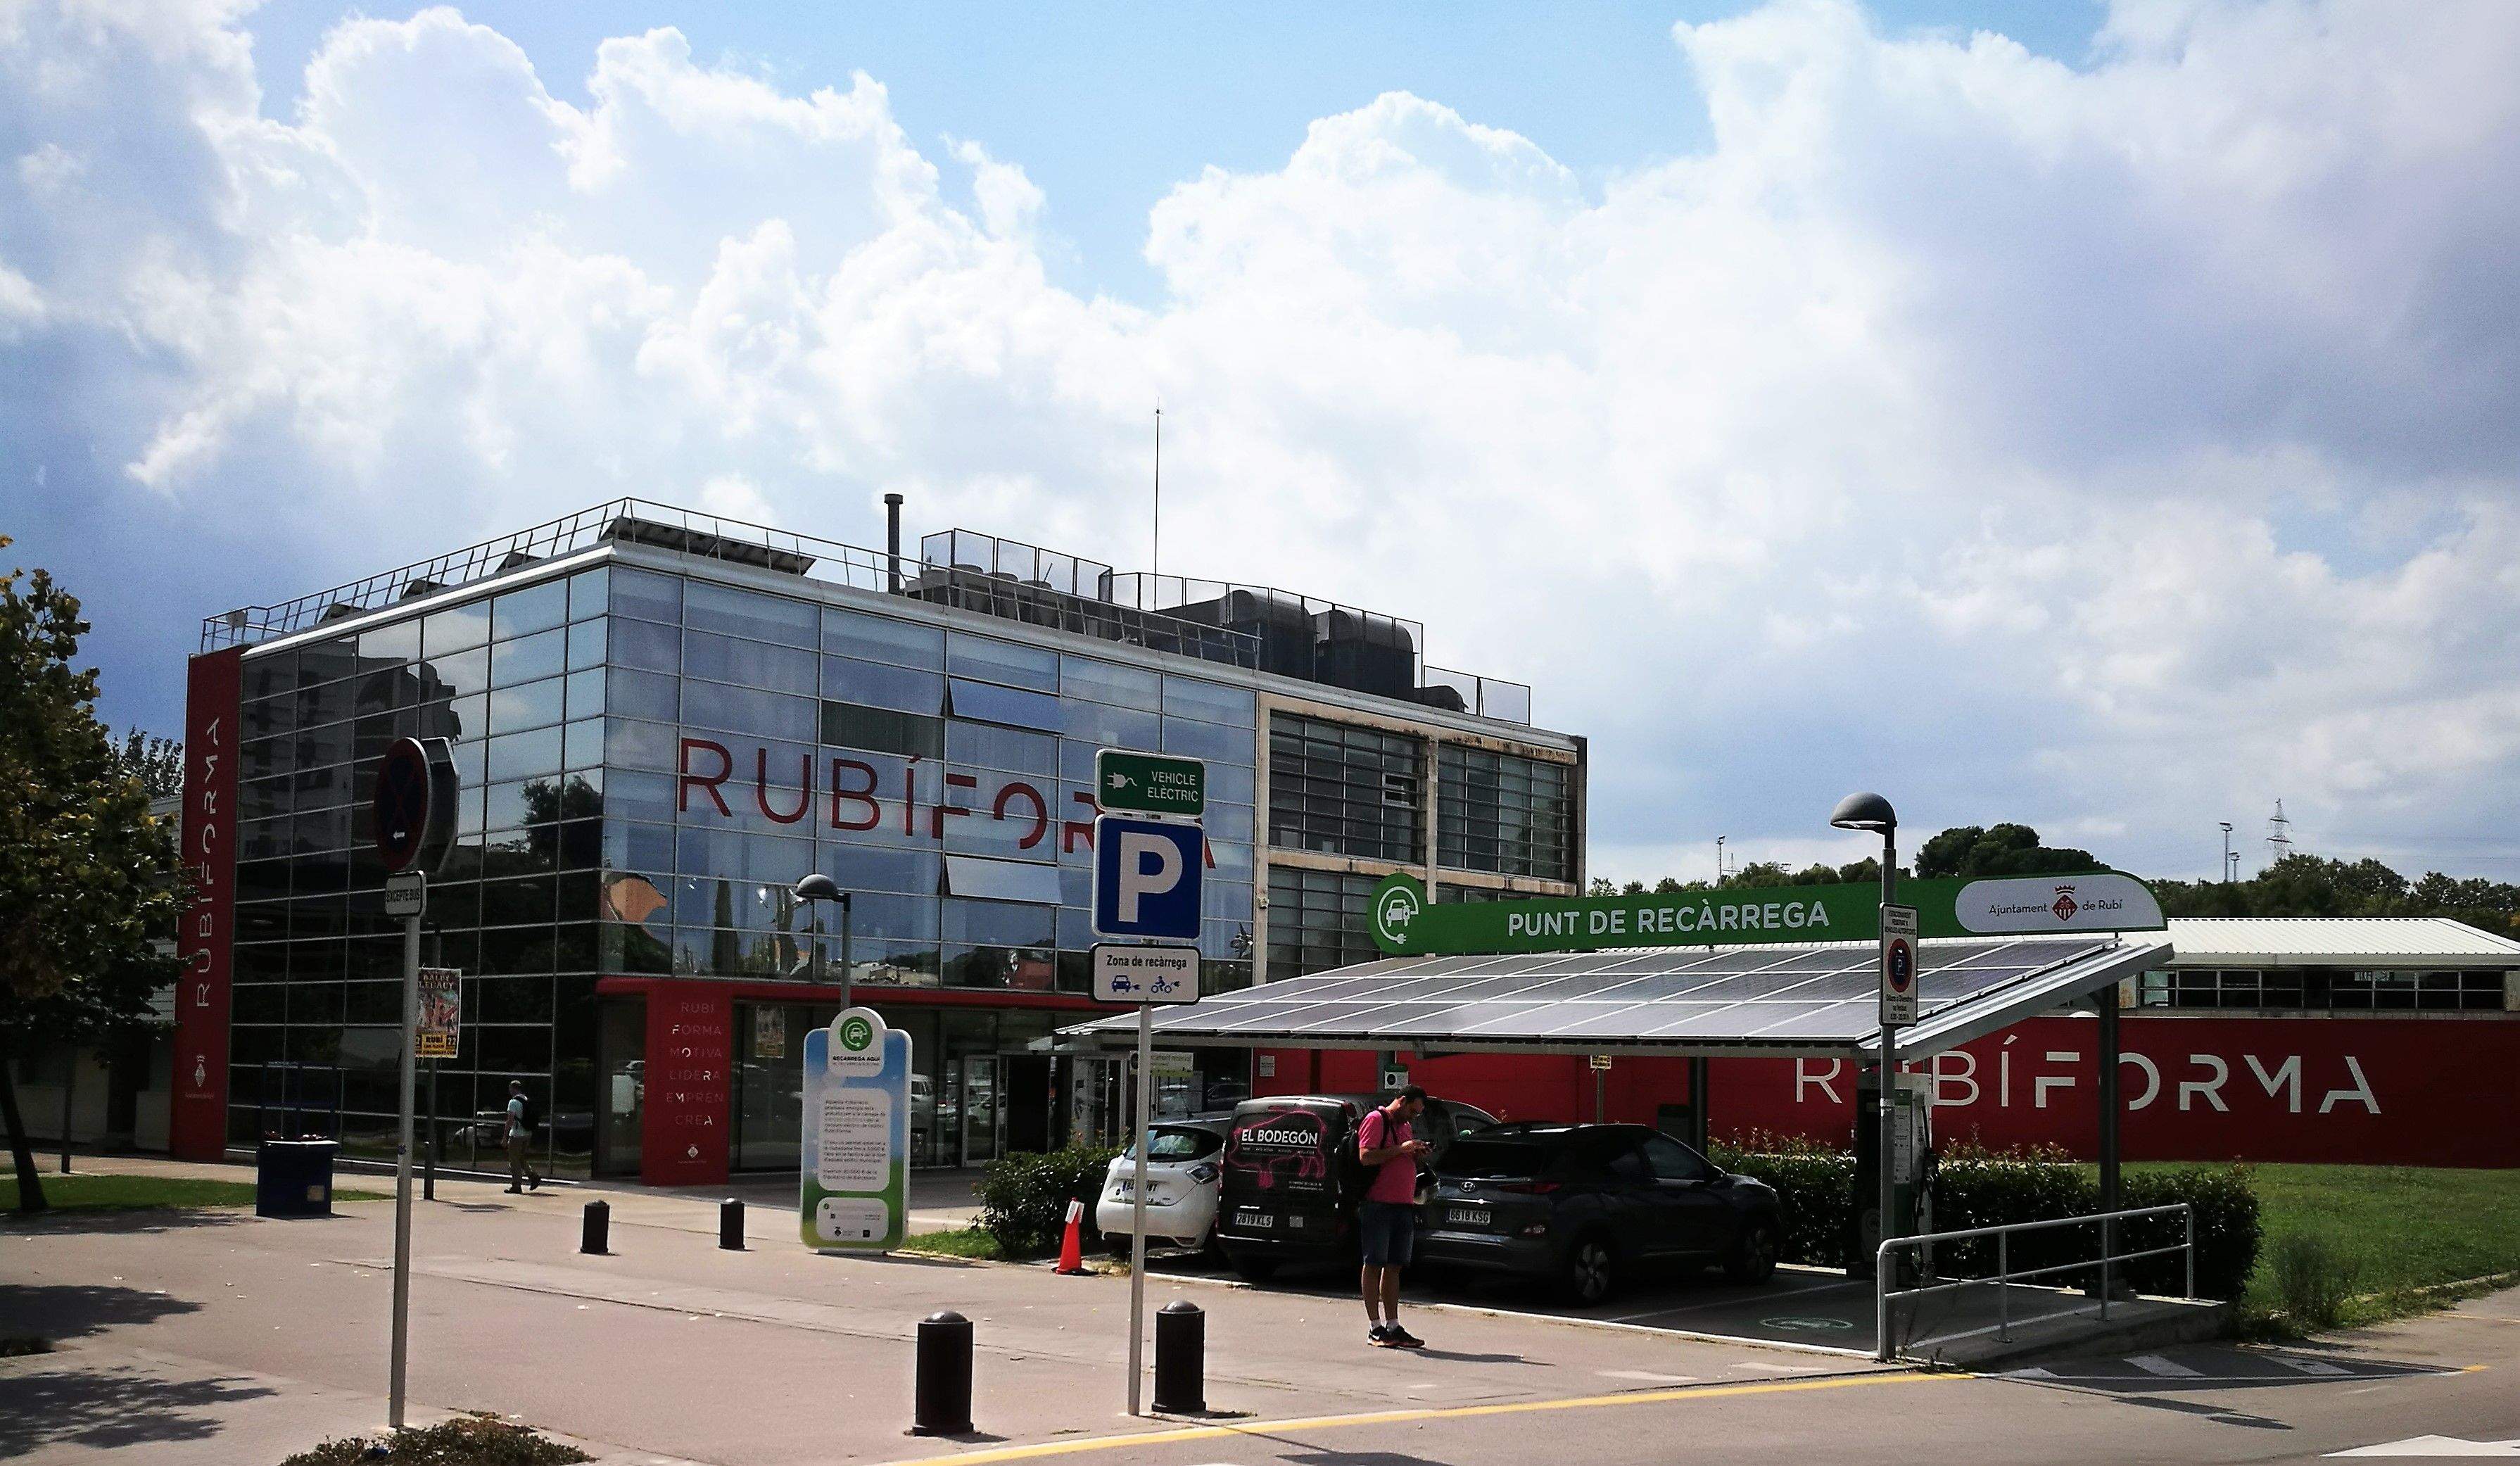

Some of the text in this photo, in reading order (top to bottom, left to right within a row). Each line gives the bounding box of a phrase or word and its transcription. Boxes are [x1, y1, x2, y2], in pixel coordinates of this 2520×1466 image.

[1152, 771, 1196, 785] VEHICLE
[1148, 785, 1198, 802] ELÈCTRIC
[679, 738, 1216, 868] RUBÍFOR
[1118, 831, 1183, 923] P
[1989, 899, 2123, 917] Ajuntament de Rubí
[1509, 898, 1829, 937] PUNT DE RECÀRREGA
[1107, 954, 1187, 971] Zona de recàrrega
[672, 1024, 722, 1036] FORMA
[670, 1047, 723, 1059] MOTIVA
[670, 1070, 721, 1082] LIDERA
[1796, 1035, 2381, 1115] RBÍFORMA
[666, 1092, 724, 1104] EMPREN
[675, 1115, 714, 1126] CREA
[1241, 1129, 1318, 1144] EL BODEGÓN
